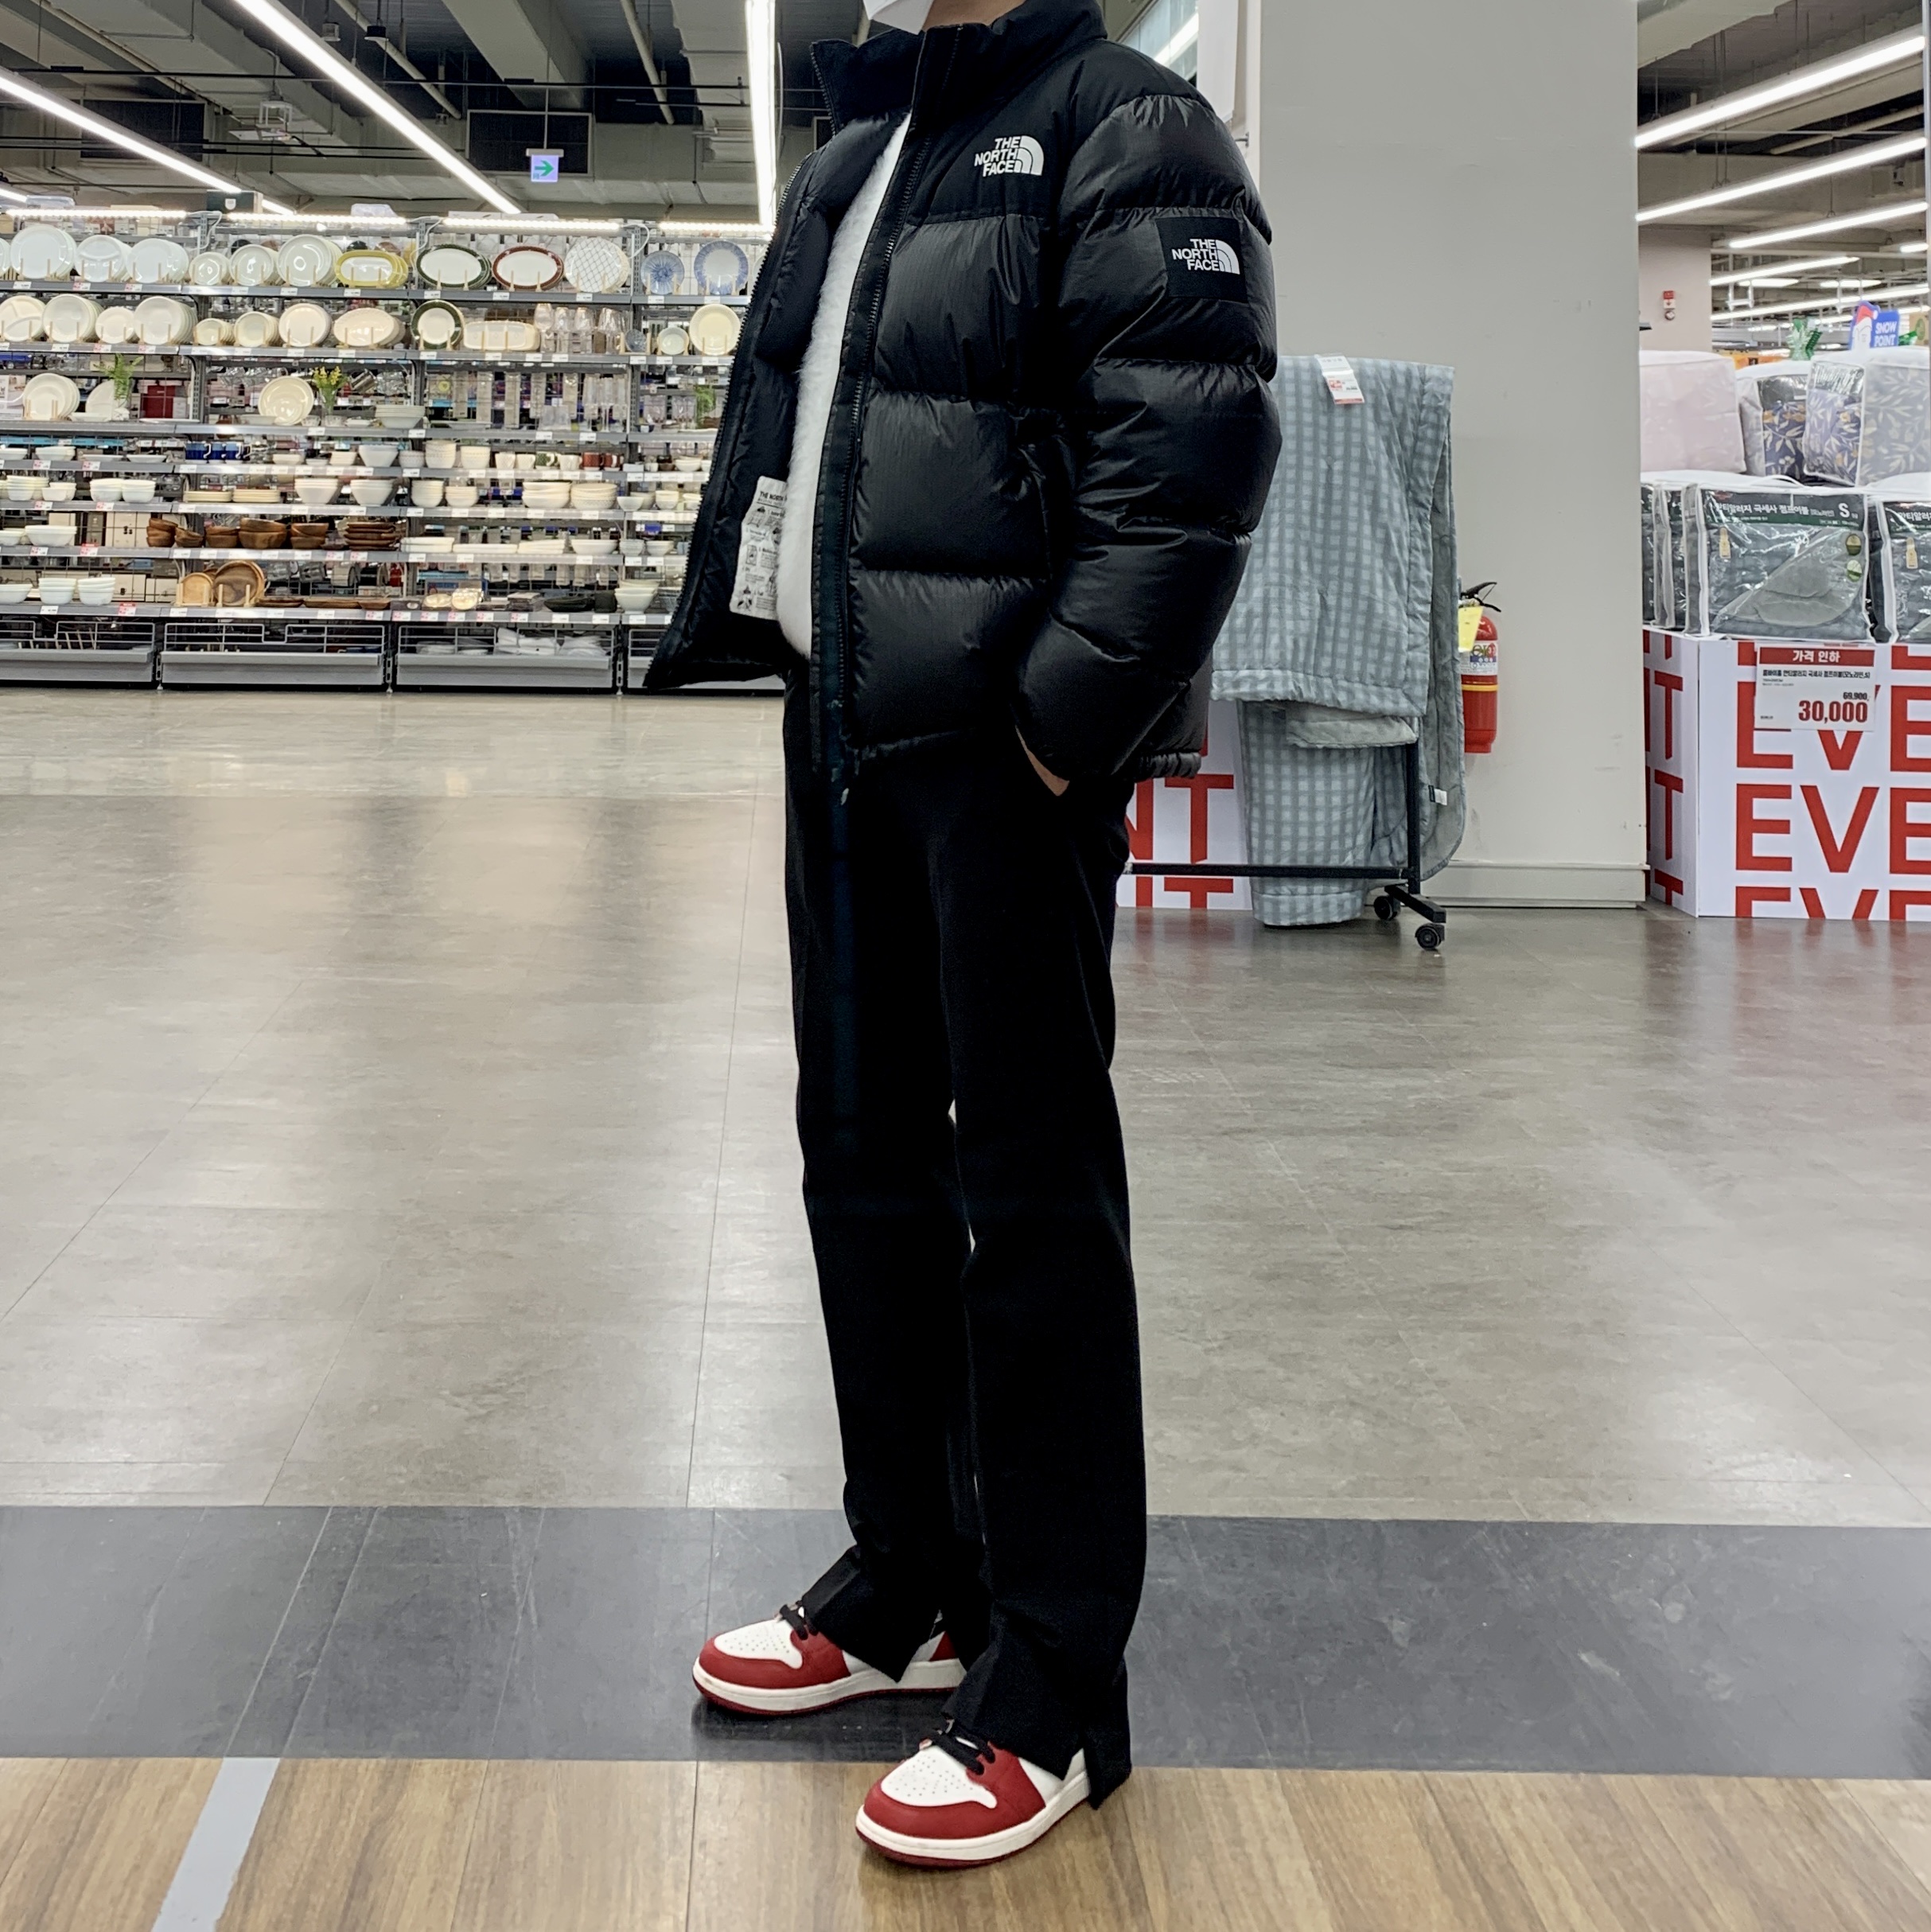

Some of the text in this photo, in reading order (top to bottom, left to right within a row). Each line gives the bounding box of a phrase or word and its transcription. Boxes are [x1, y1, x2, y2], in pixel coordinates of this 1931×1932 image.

[995, 136, 1021, 150] THE
[974, 148, 1018, 167] NORTH
[983, 160, 1016, 177] FACE
[1189, 239, 1217, 249] THE
[1171, 248, 1218, 260] NORTH
[1186, 259, 1220, 271] FACE
[1875, 321, 1898, 334] SNOW
[1875, 334, 1896, 346] POINT
[1838, 502, 1850, 518] S
[1793, 650, 1840, 663] 가격 인하
[1798, 700, 1868, 723] 30,000
